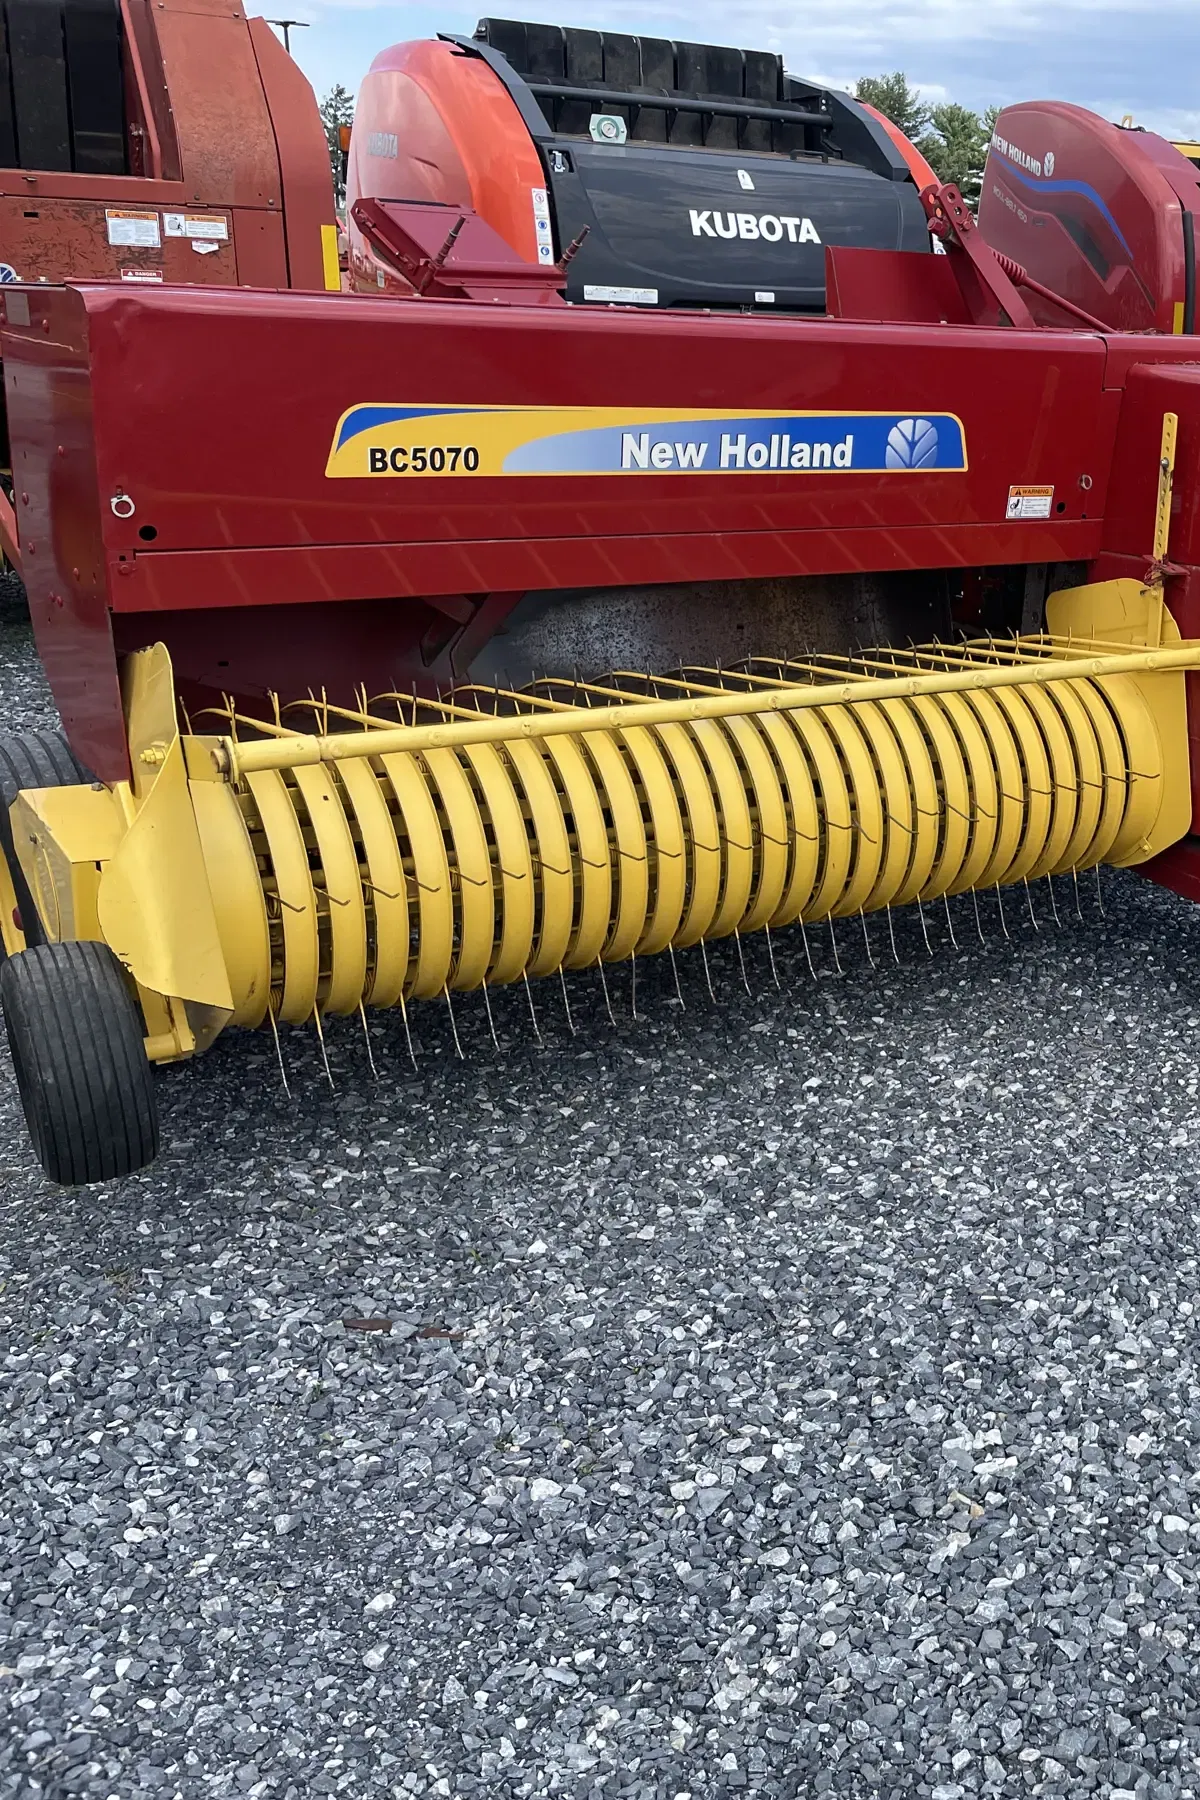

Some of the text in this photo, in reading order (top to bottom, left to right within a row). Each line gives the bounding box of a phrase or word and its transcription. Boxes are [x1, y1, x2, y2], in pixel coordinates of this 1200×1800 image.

[991, 132, 1041, 177] NEW HOLLAND
[688, 209, 822, 244] KUBOTA
[368, 446, 480, 473] BC5070
[620, 433, 854, 469] New Holland
